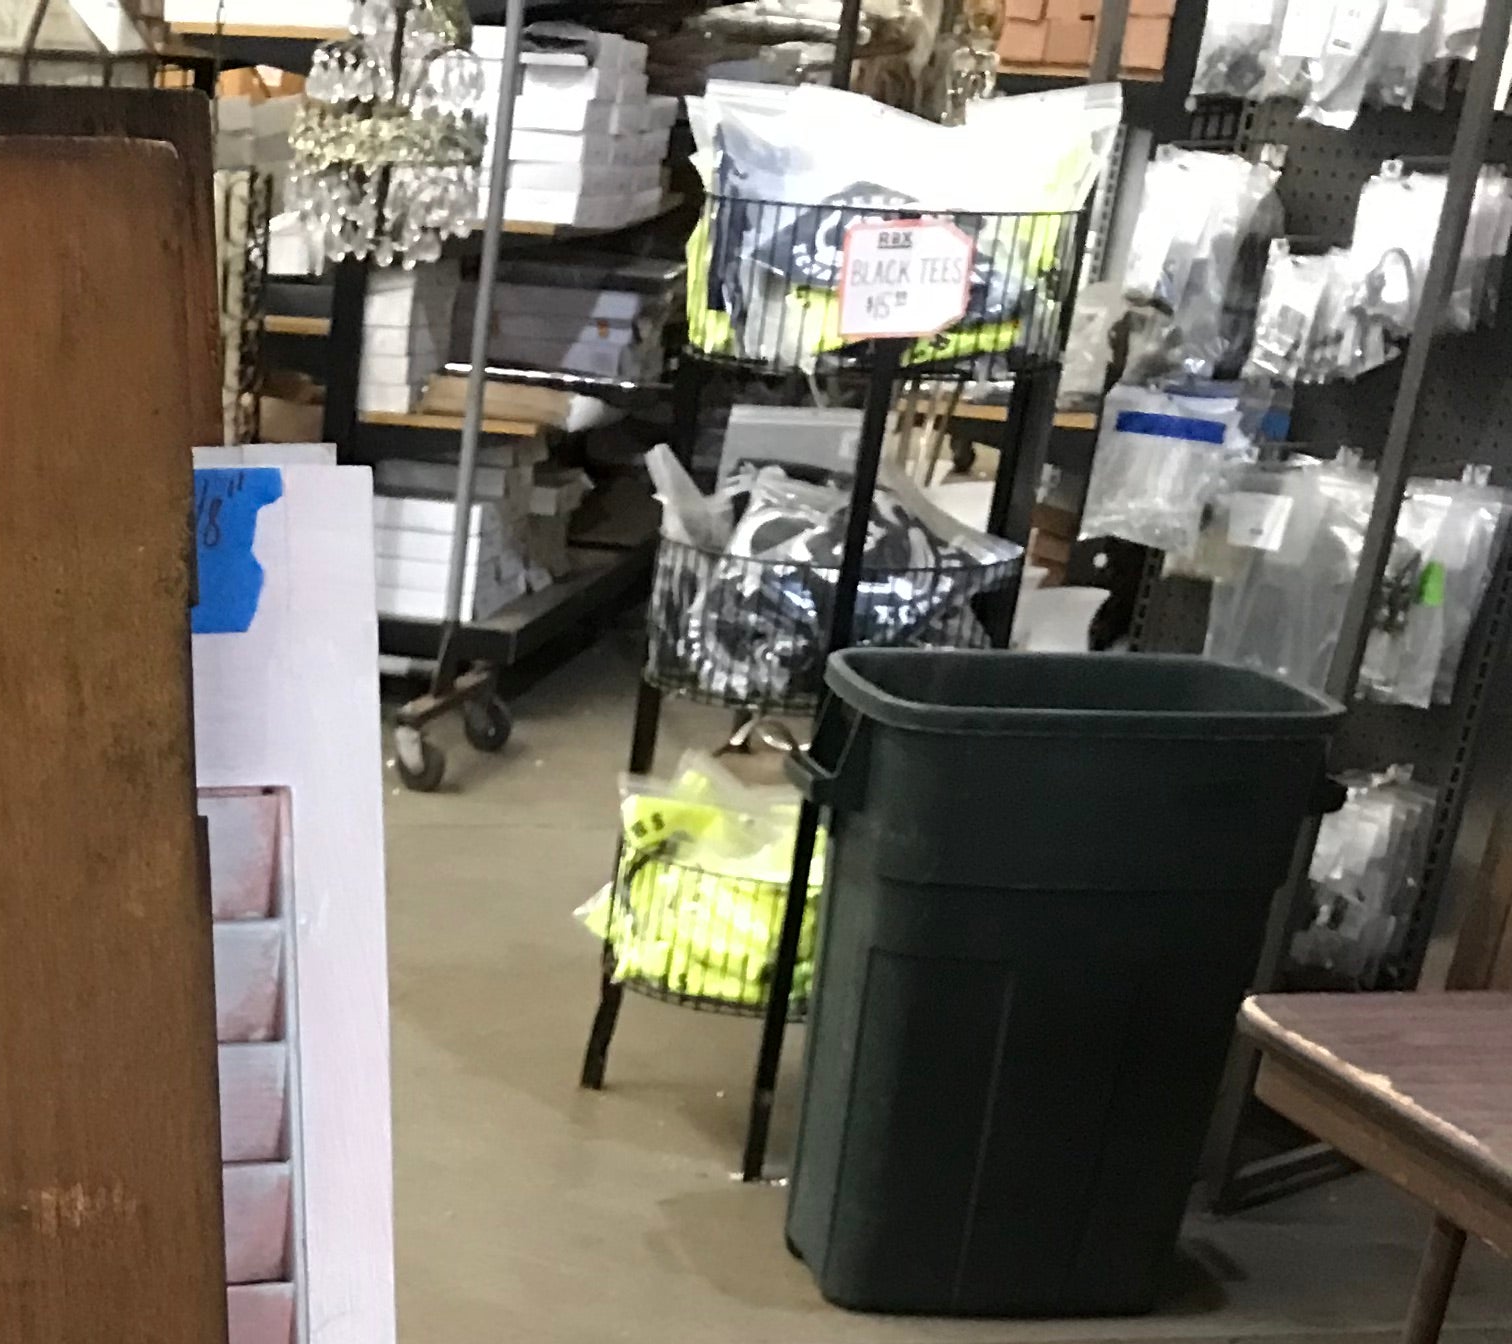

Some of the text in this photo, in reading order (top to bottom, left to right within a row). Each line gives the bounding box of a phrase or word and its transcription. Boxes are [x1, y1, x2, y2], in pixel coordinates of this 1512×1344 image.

[878, 231, 913, 246] RBX
[850, 258, 911, 286] BLACK
[919, 257, 963, 284] TEES
